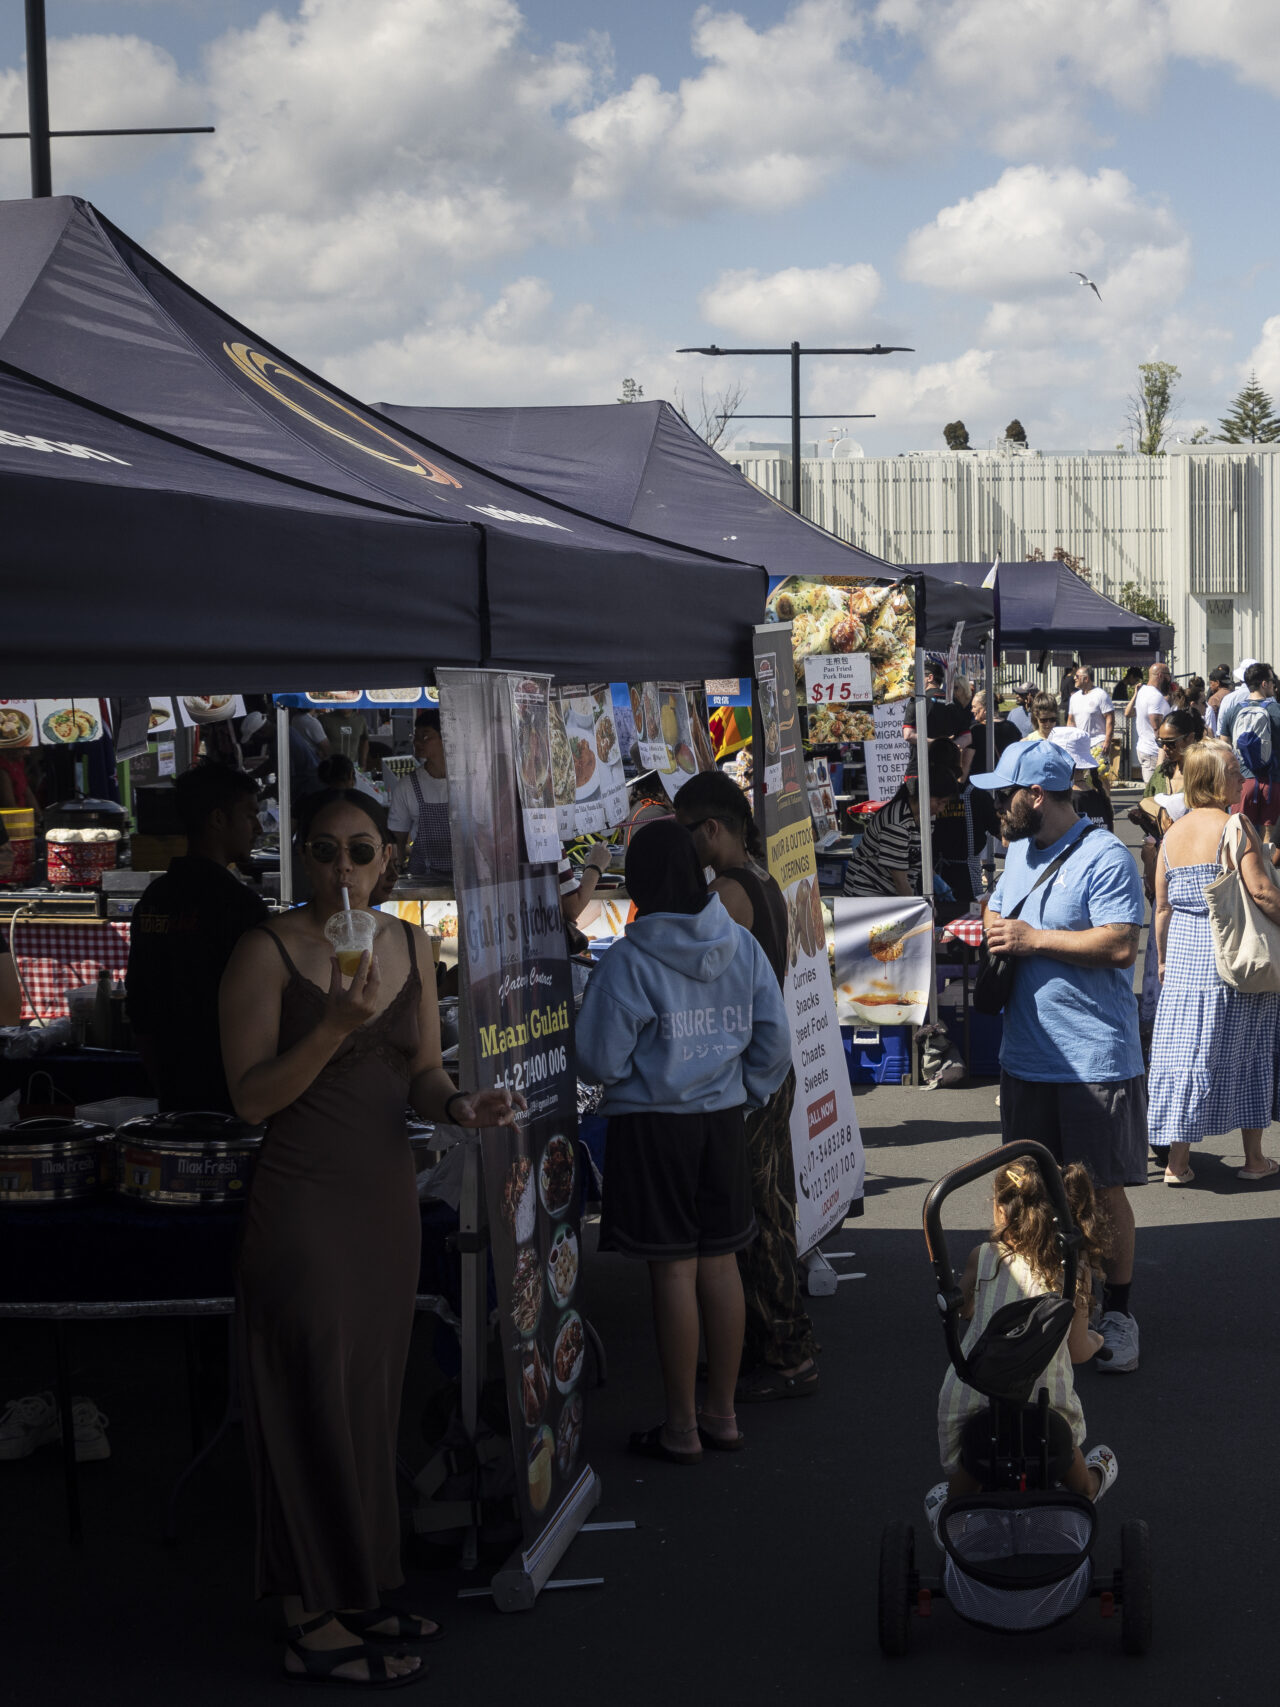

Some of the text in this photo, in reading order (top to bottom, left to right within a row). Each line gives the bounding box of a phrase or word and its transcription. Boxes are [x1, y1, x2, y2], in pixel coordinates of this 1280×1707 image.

[811, 682, 852, 703] $15
[876, 753, 891, 761] THE
[877, 764, 888, 773] TO
[878, 775, 885, 783] IN
[793, 967, 817, 990] Curries
[796, 992, 820, 1017] Snacks
[530, 1000, 569, 1039] Gulati
[661, 1007, 719, 1040] EISURE
[811, 1010, 829, 1034] Food
[683, 1041, 738, 1060] レジャー
[801, 1043, 826, 1067] Chaats
[805, 1068, 829, 1094] Sweets
[820, 1098, 834, 1119] NOW
[41, 1157, 95, 1174] Max Fresh
[178, 1158, 237, 1174] Max Fresh
[840, 1152, 856, 1175] 100
